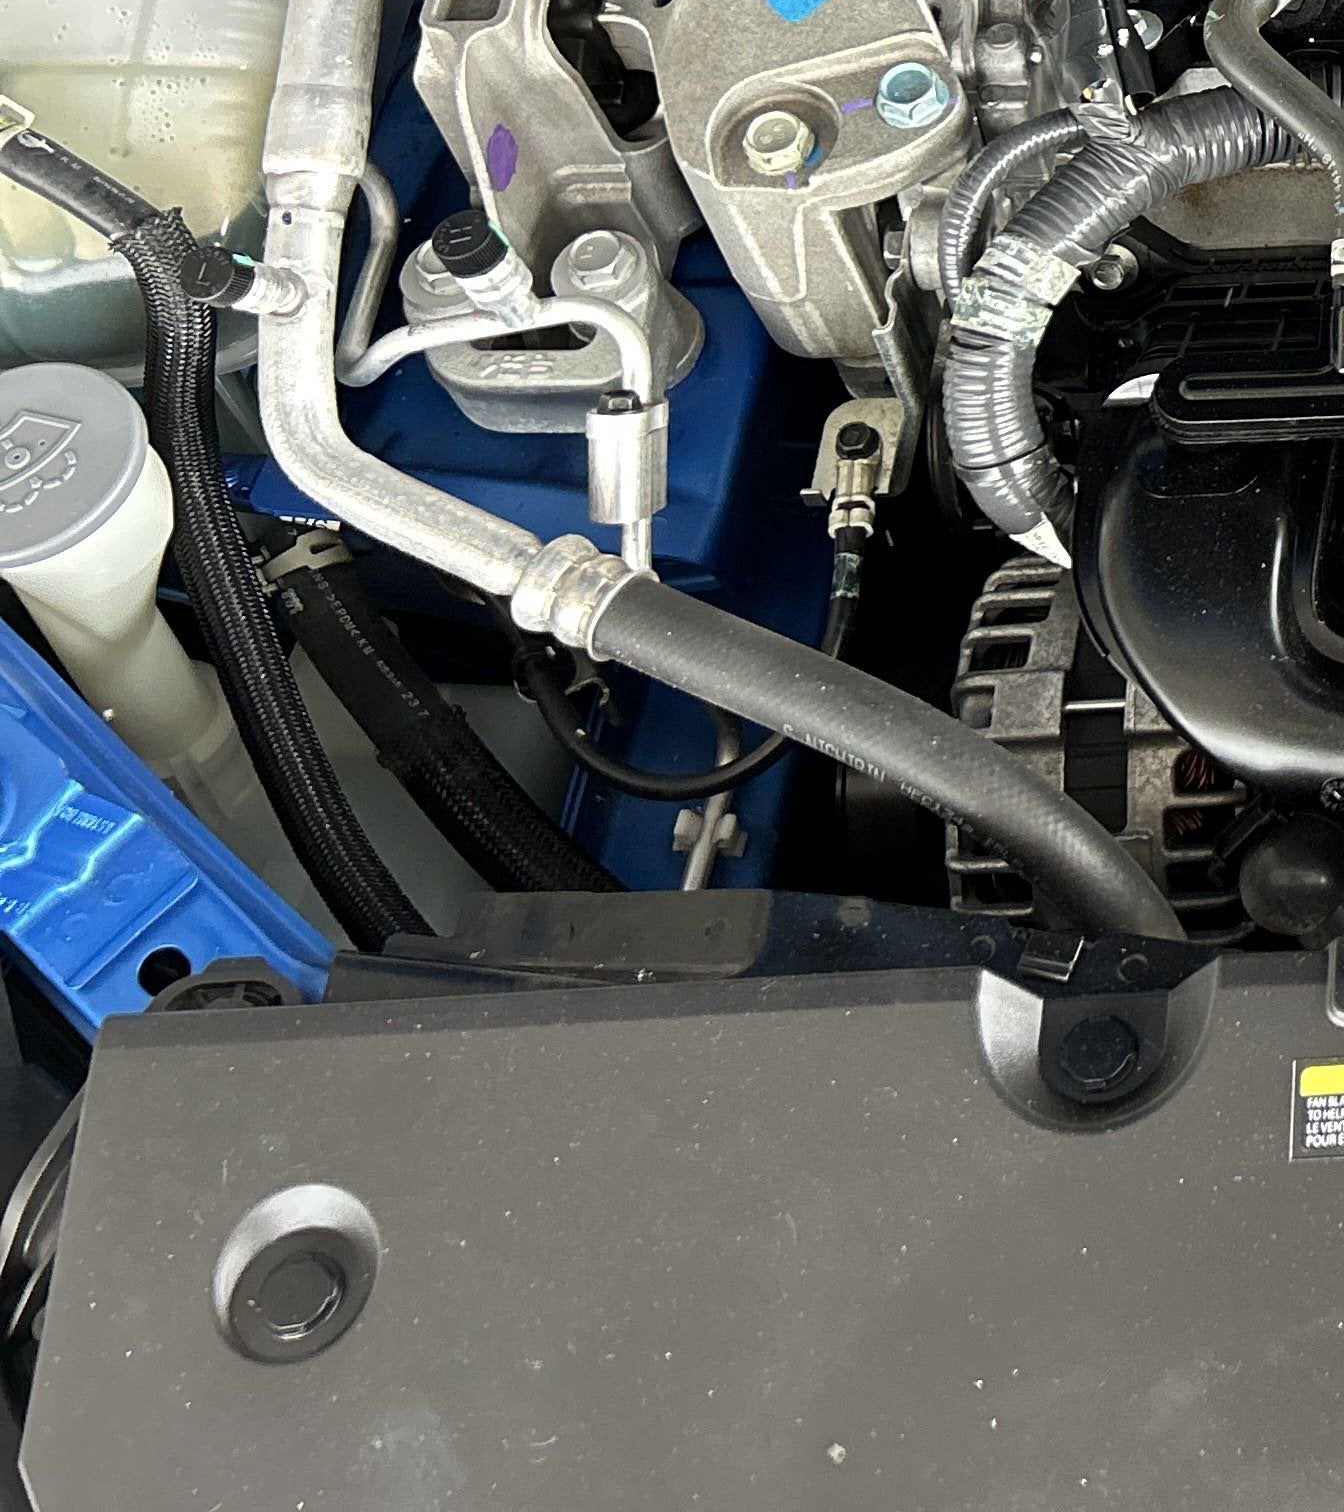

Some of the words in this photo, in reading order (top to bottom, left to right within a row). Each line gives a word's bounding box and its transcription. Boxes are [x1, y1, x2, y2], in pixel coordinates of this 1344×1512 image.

[1307, 1096, 1326, 1108] FAN
[1307, 1110, 1321, 1121] TO
[1306, 1122, 1320, 1134] LE
[1306, 1135, 1336, 1148] POUR
